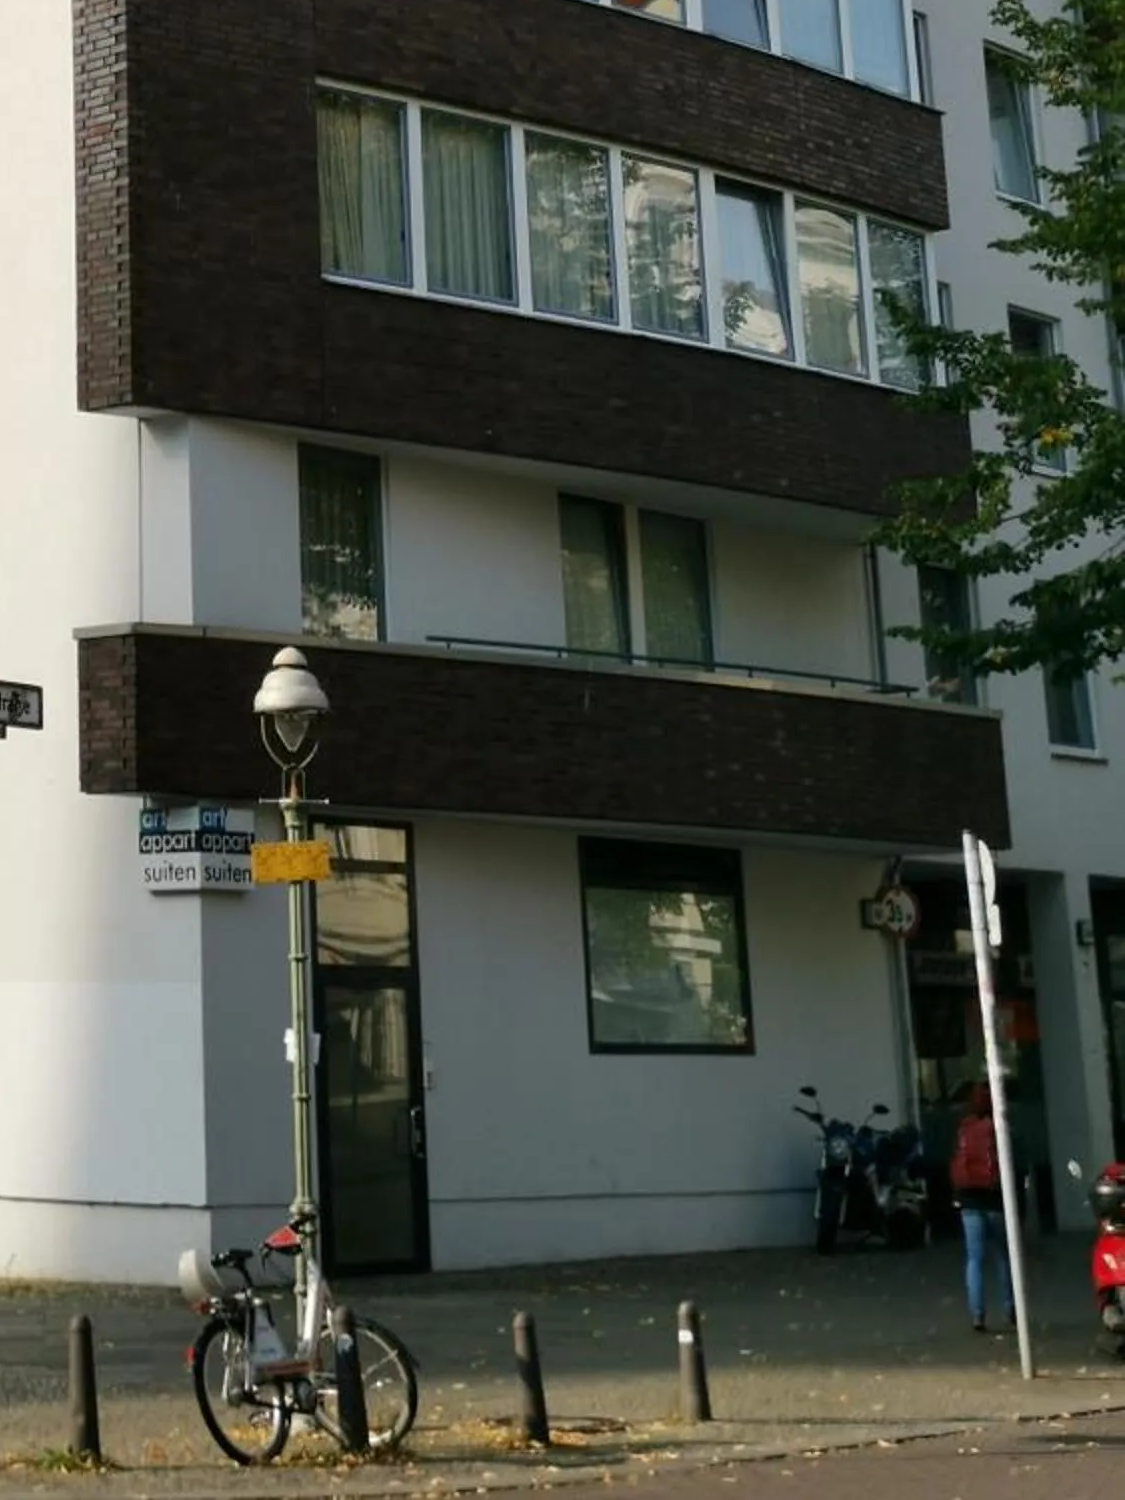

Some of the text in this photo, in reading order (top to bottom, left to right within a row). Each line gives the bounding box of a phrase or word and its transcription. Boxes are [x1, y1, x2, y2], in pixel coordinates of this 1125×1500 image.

[140, 831, 196, 854] appart
[144, 860, 196, 882] suiten
[204, 858, 252, 883] suiten
